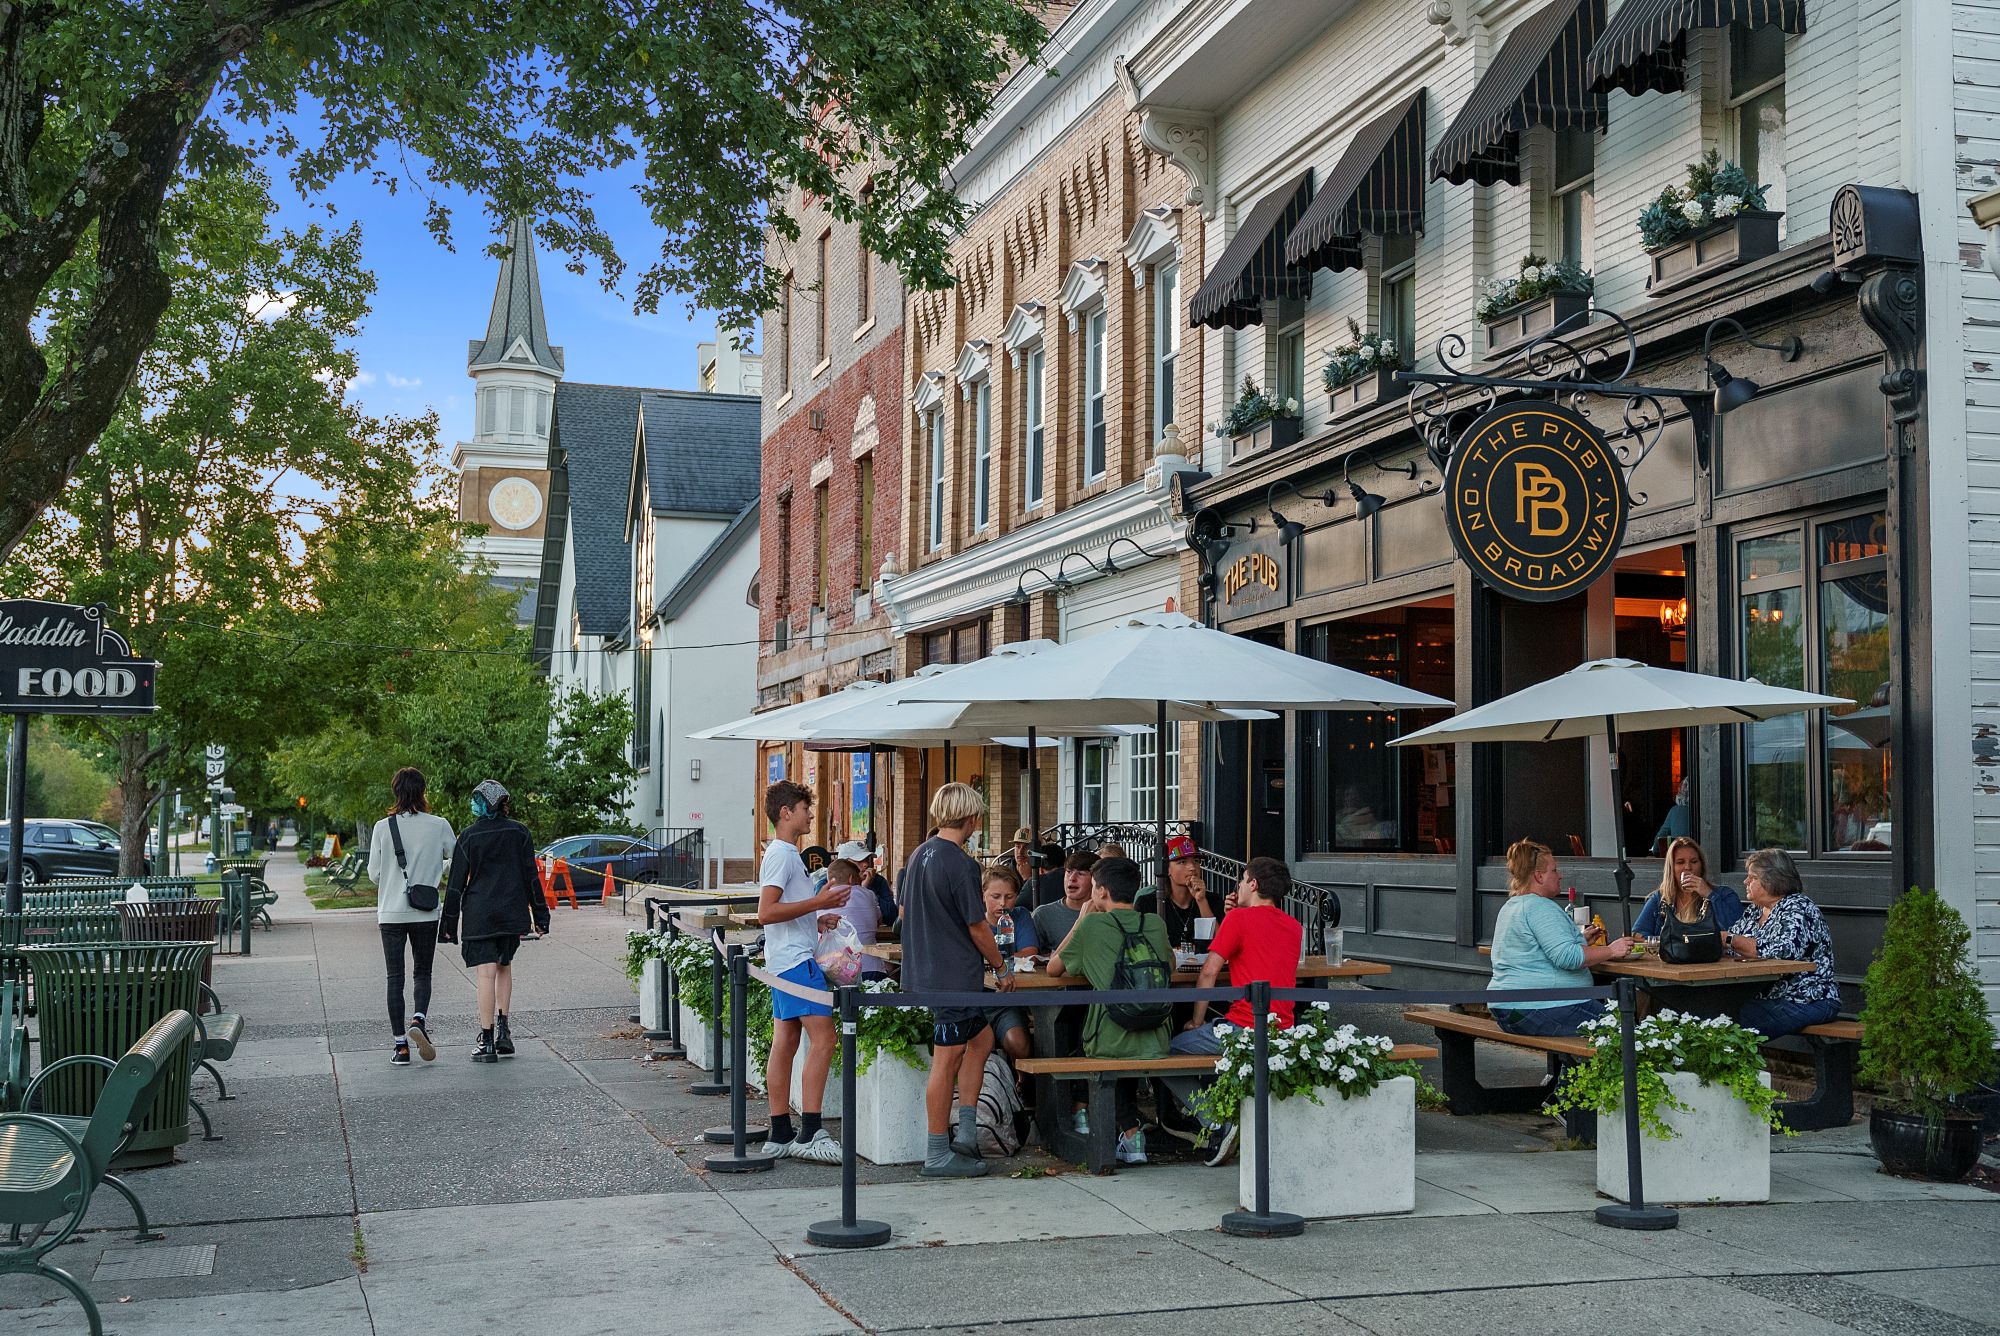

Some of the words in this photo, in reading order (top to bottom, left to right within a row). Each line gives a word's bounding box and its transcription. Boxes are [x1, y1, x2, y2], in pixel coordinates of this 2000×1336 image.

[1472, 422, 1528, 463] THE
[1542, 422, 1598, 469] PUB
[1465, 489, 1485, 531] ON
[1484, 492, 1610, 581] BROADWAY
[1223, 556, 1248, 605] THE
[1251, 553, 1279, 592] PUB
[0, 612, 89, 647] laddin
[18, 667, 137, 698] FOOD
[210, 744, 222, 755] 16
[208, 763, 223, 774] 37
